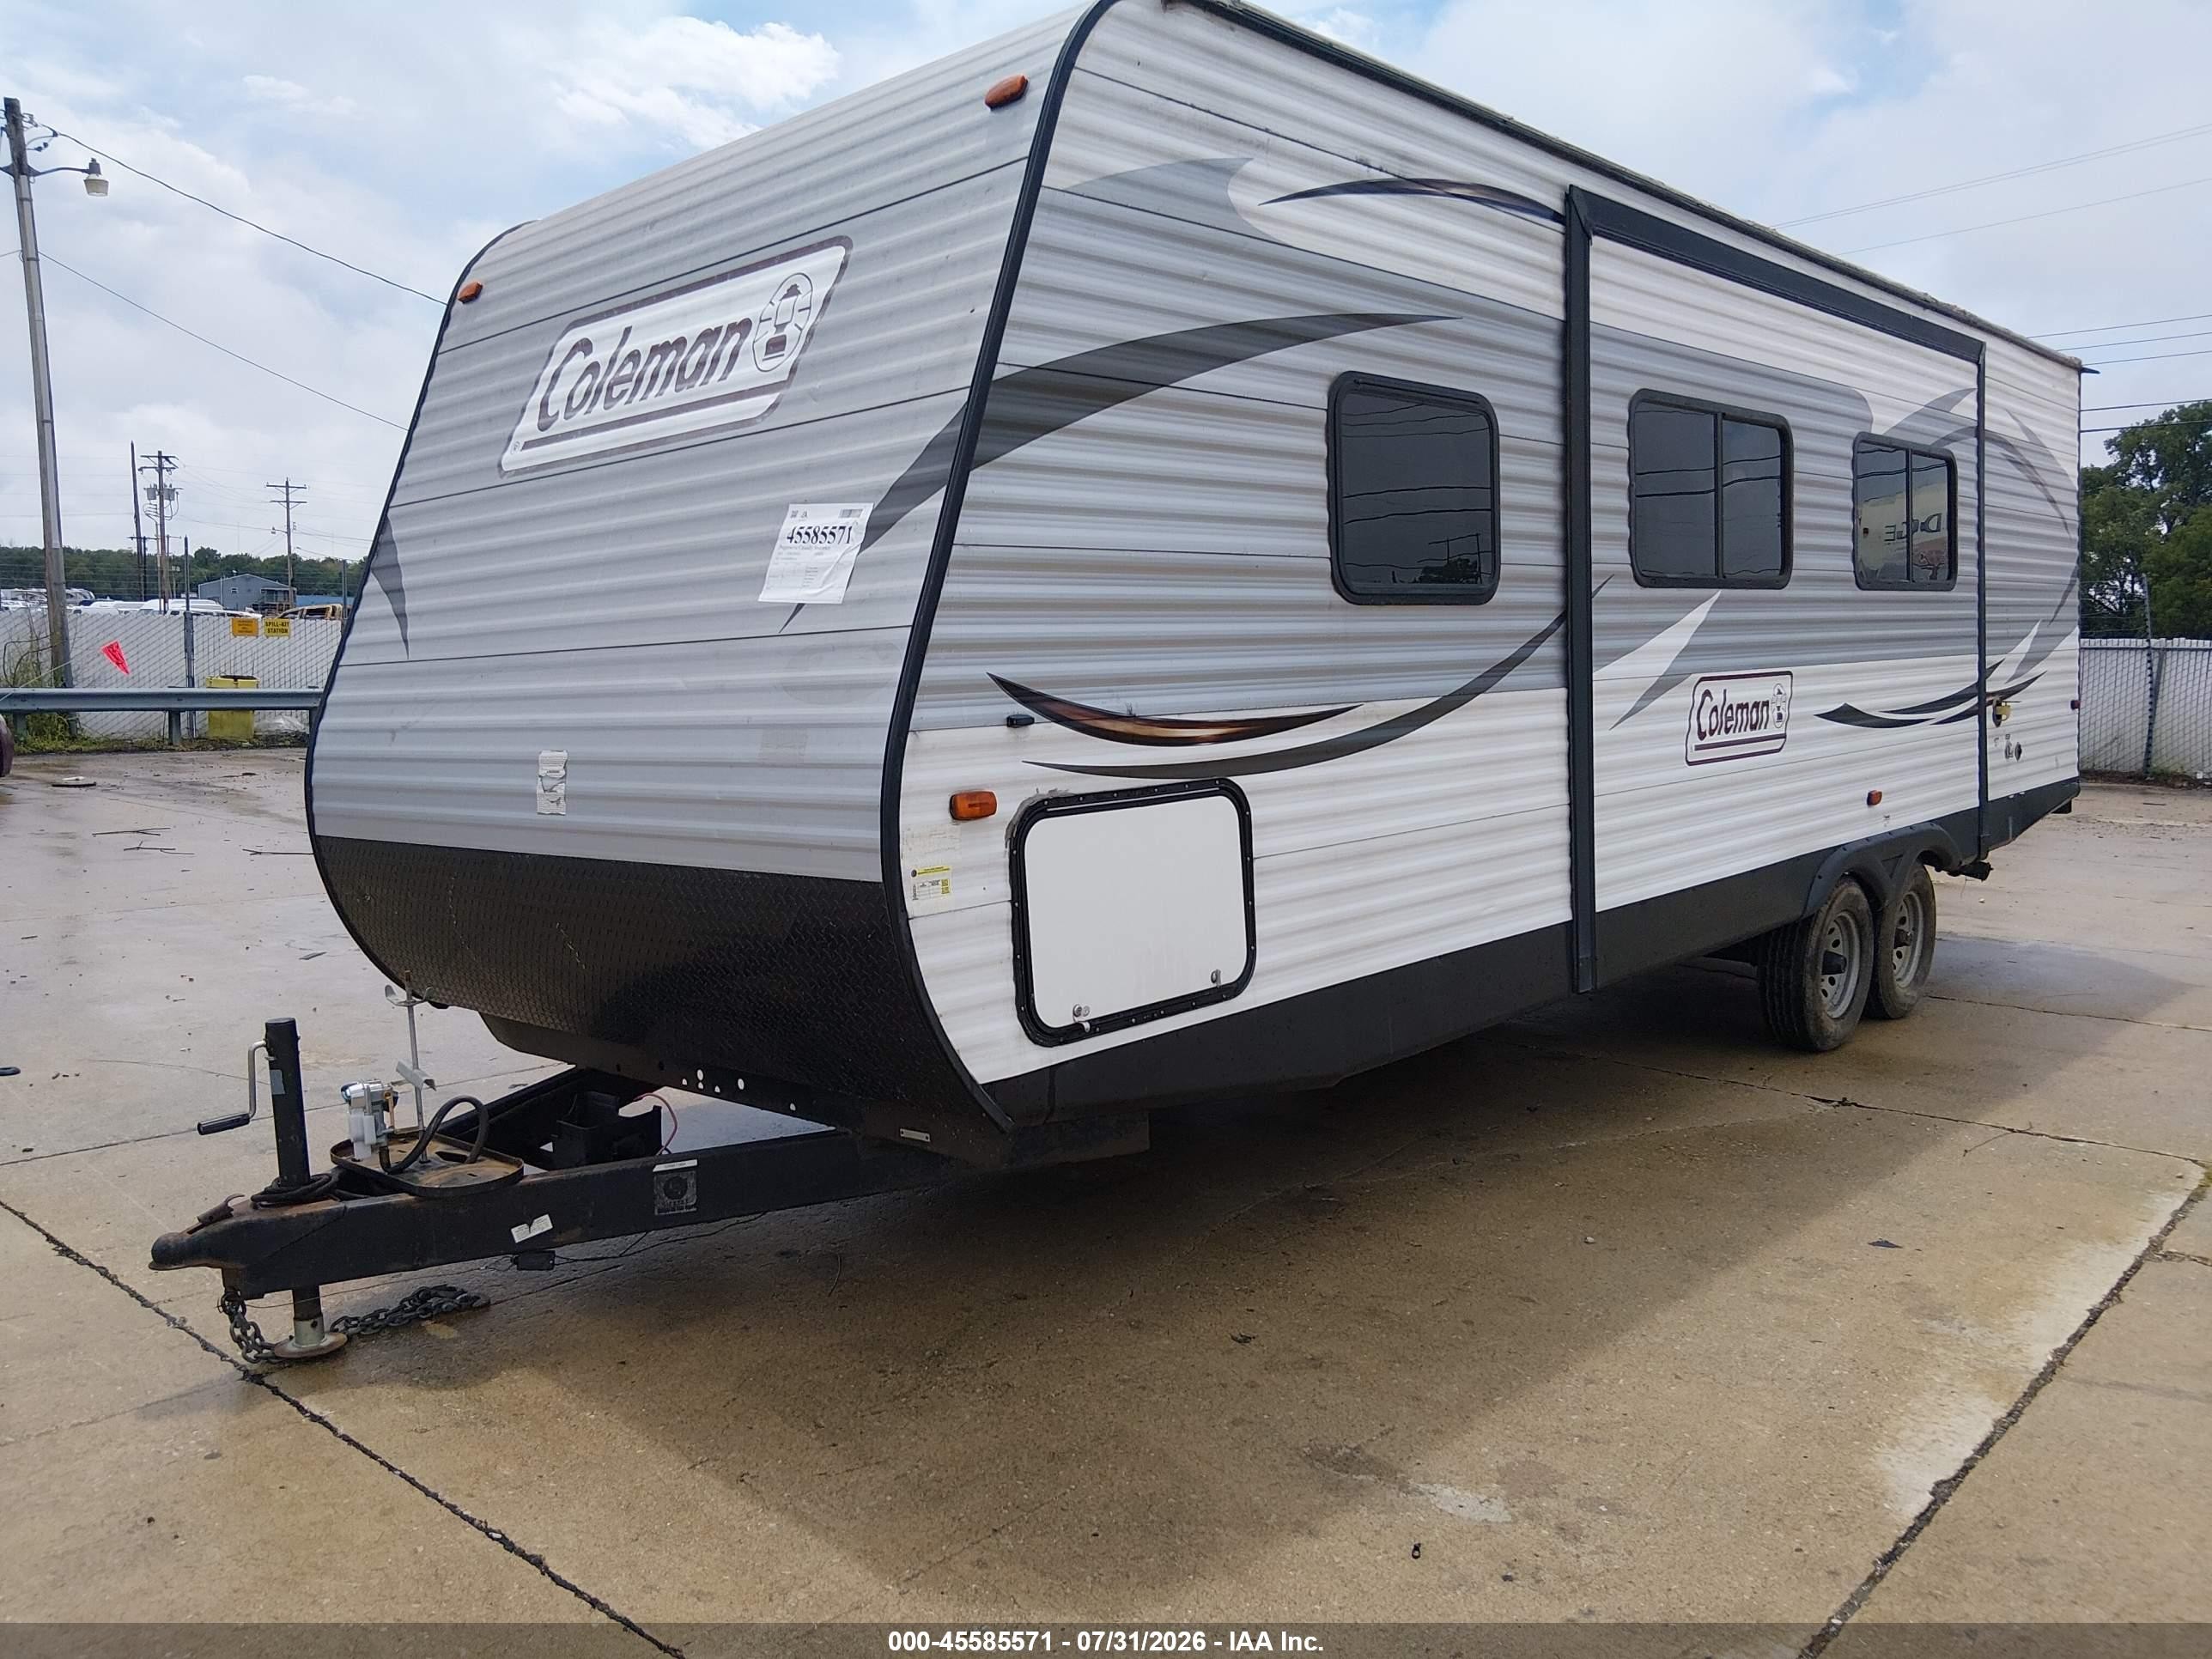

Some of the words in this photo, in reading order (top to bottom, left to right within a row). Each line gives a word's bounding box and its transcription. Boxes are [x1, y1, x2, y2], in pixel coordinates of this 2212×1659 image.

[537, 317, 753, 432] Coleman
[787, 526, 853, 544] 45585571
[1696, 689, 1770, 741] Coleman
